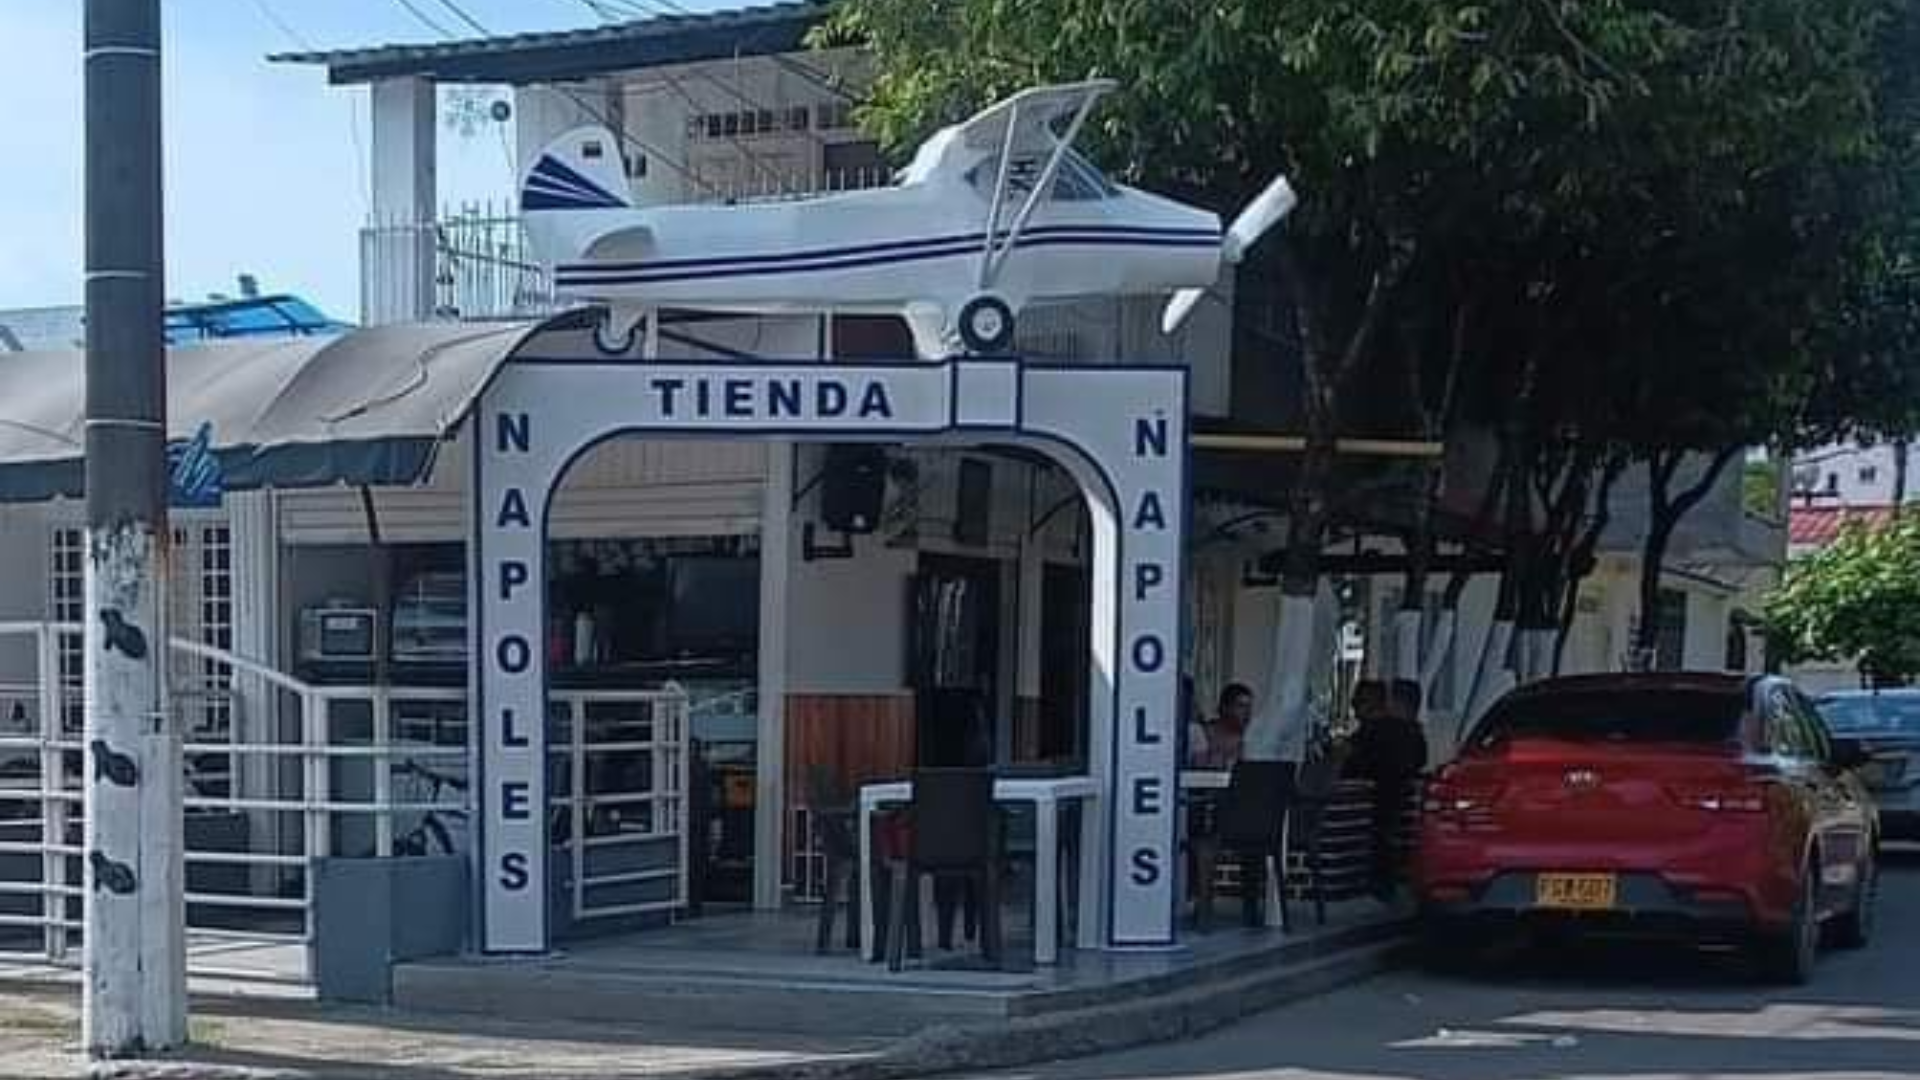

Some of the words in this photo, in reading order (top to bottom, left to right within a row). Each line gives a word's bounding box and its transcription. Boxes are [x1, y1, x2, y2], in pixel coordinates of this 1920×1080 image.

[651, 379, 892, 418] TIENDA
[496, 413, 531, 891] NAPOLES
[1132, 418, 1168, 888] NAPOLES
